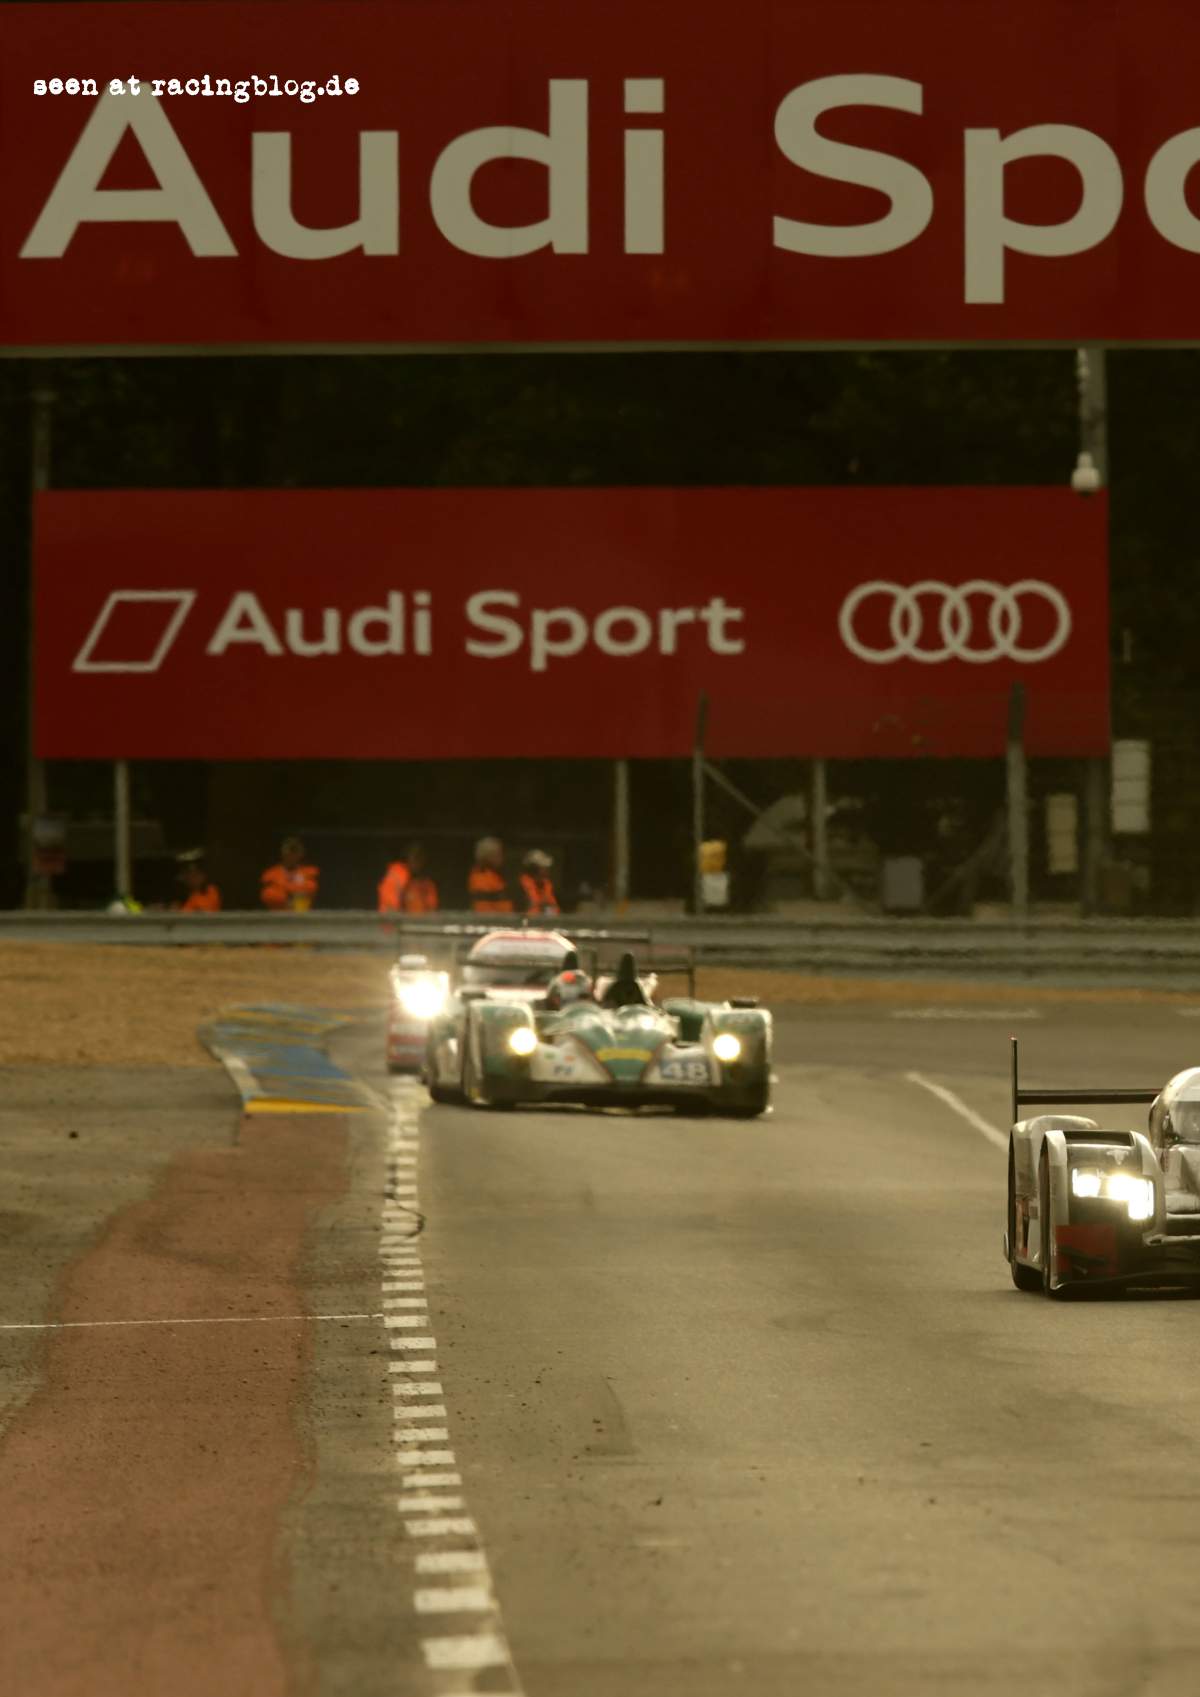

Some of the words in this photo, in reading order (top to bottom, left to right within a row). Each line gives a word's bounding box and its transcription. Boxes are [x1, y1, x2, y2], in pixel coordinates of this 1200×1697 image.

[19, 77, 664, 260] Audi
[205, 589, 432, 657] Audi
[462, 589, 745, 672] Sport
